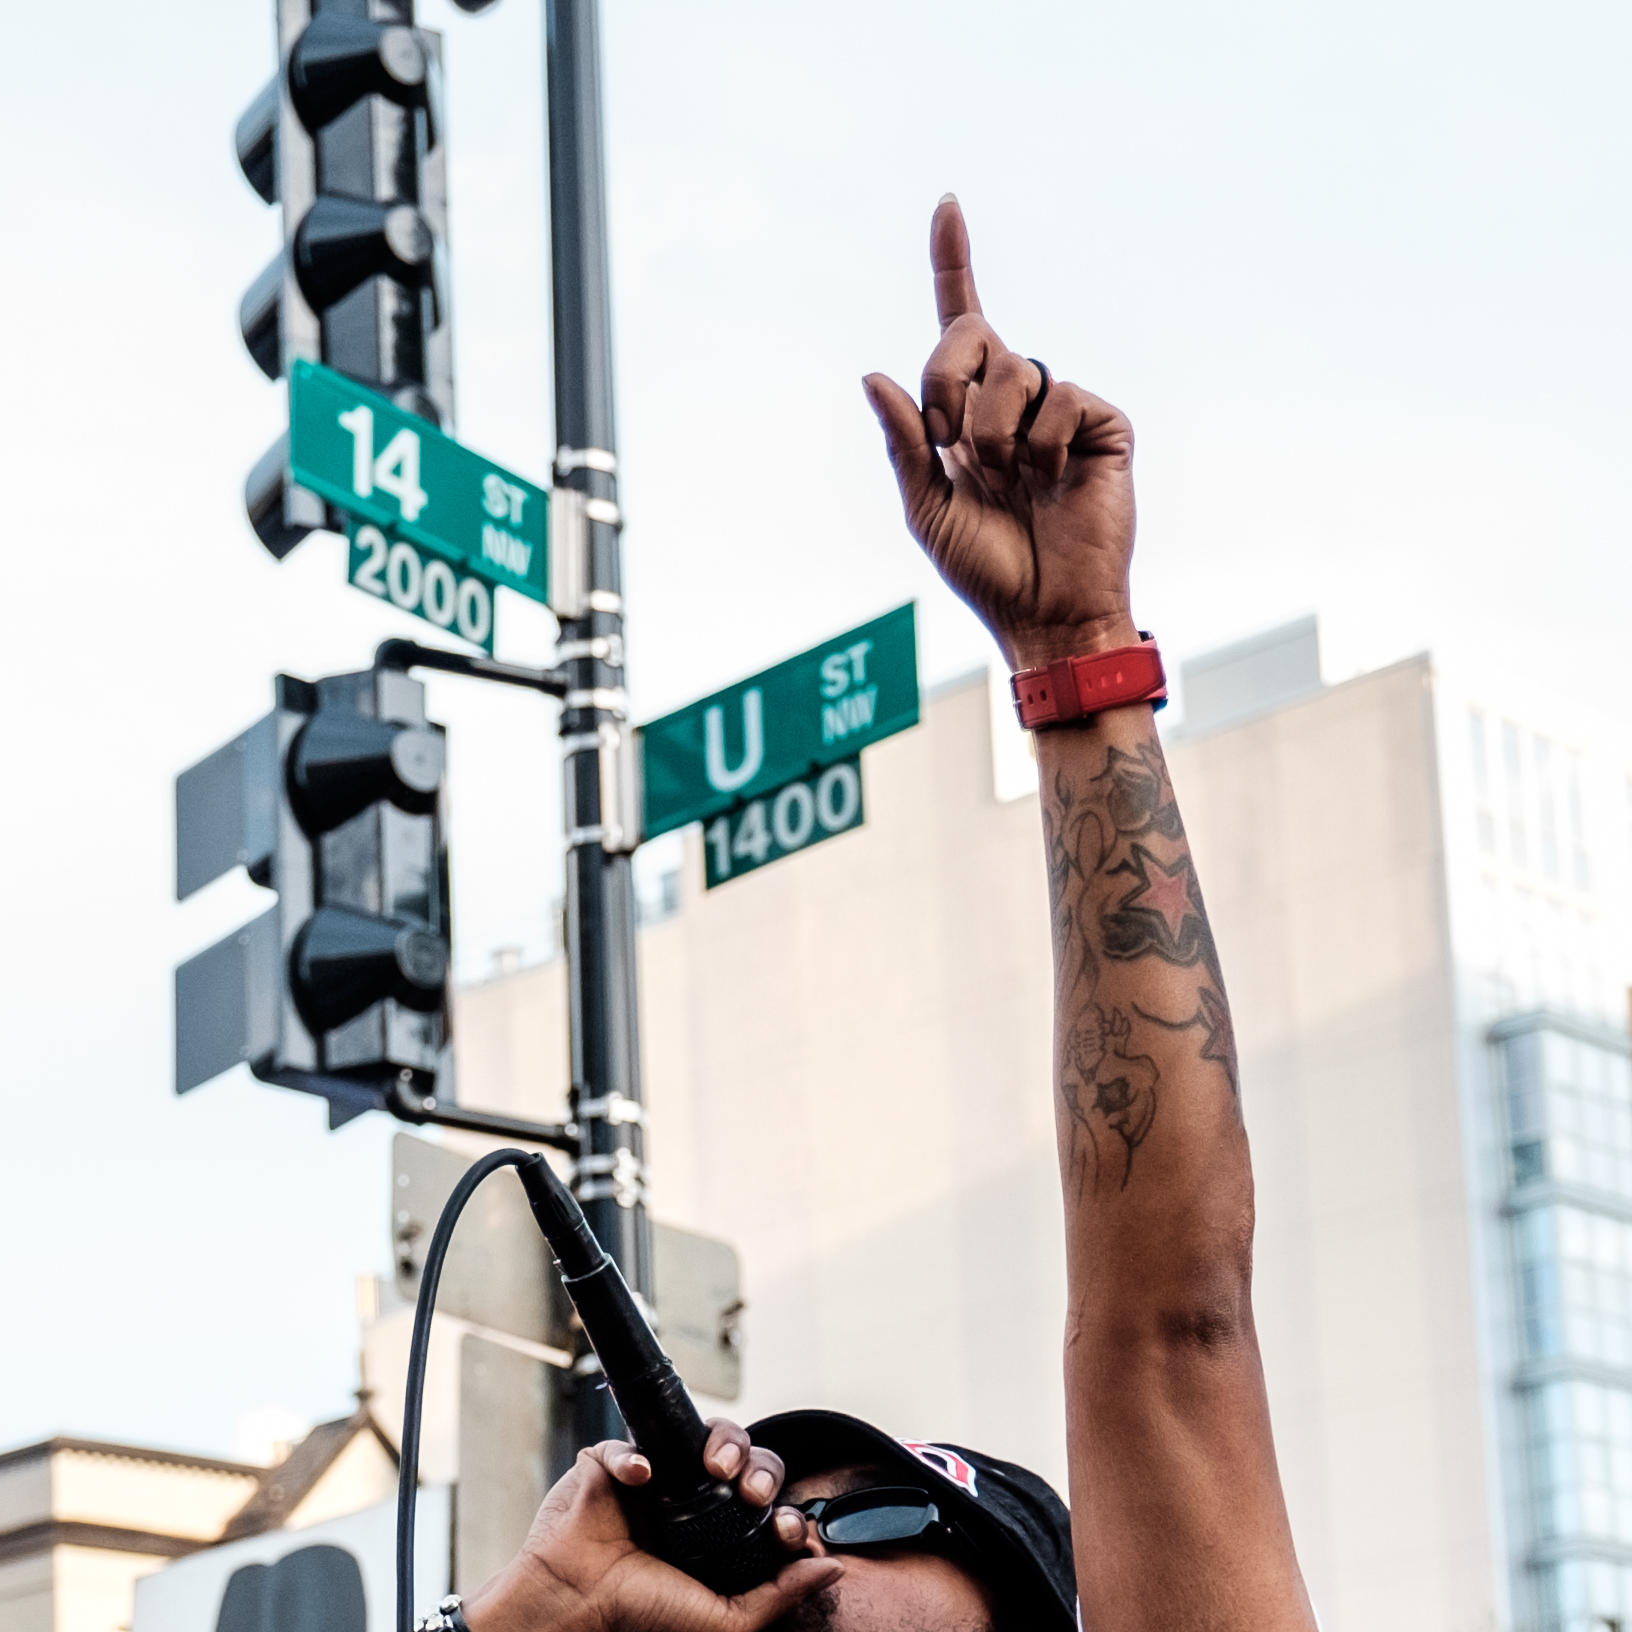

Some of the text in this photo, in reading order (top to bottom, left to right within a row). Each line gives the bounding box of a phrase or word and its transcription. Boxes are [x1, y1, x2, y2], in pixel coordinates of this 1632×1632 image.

[337, 404, 529, 525] 14 ST
[353, 526, 493, 645] 2000
[480, 525, 533, 578] NW
[703, 641, 873, 793] U ST
[820, 684, 878, 746] NW
[704, 763, 860, 878] 1400
